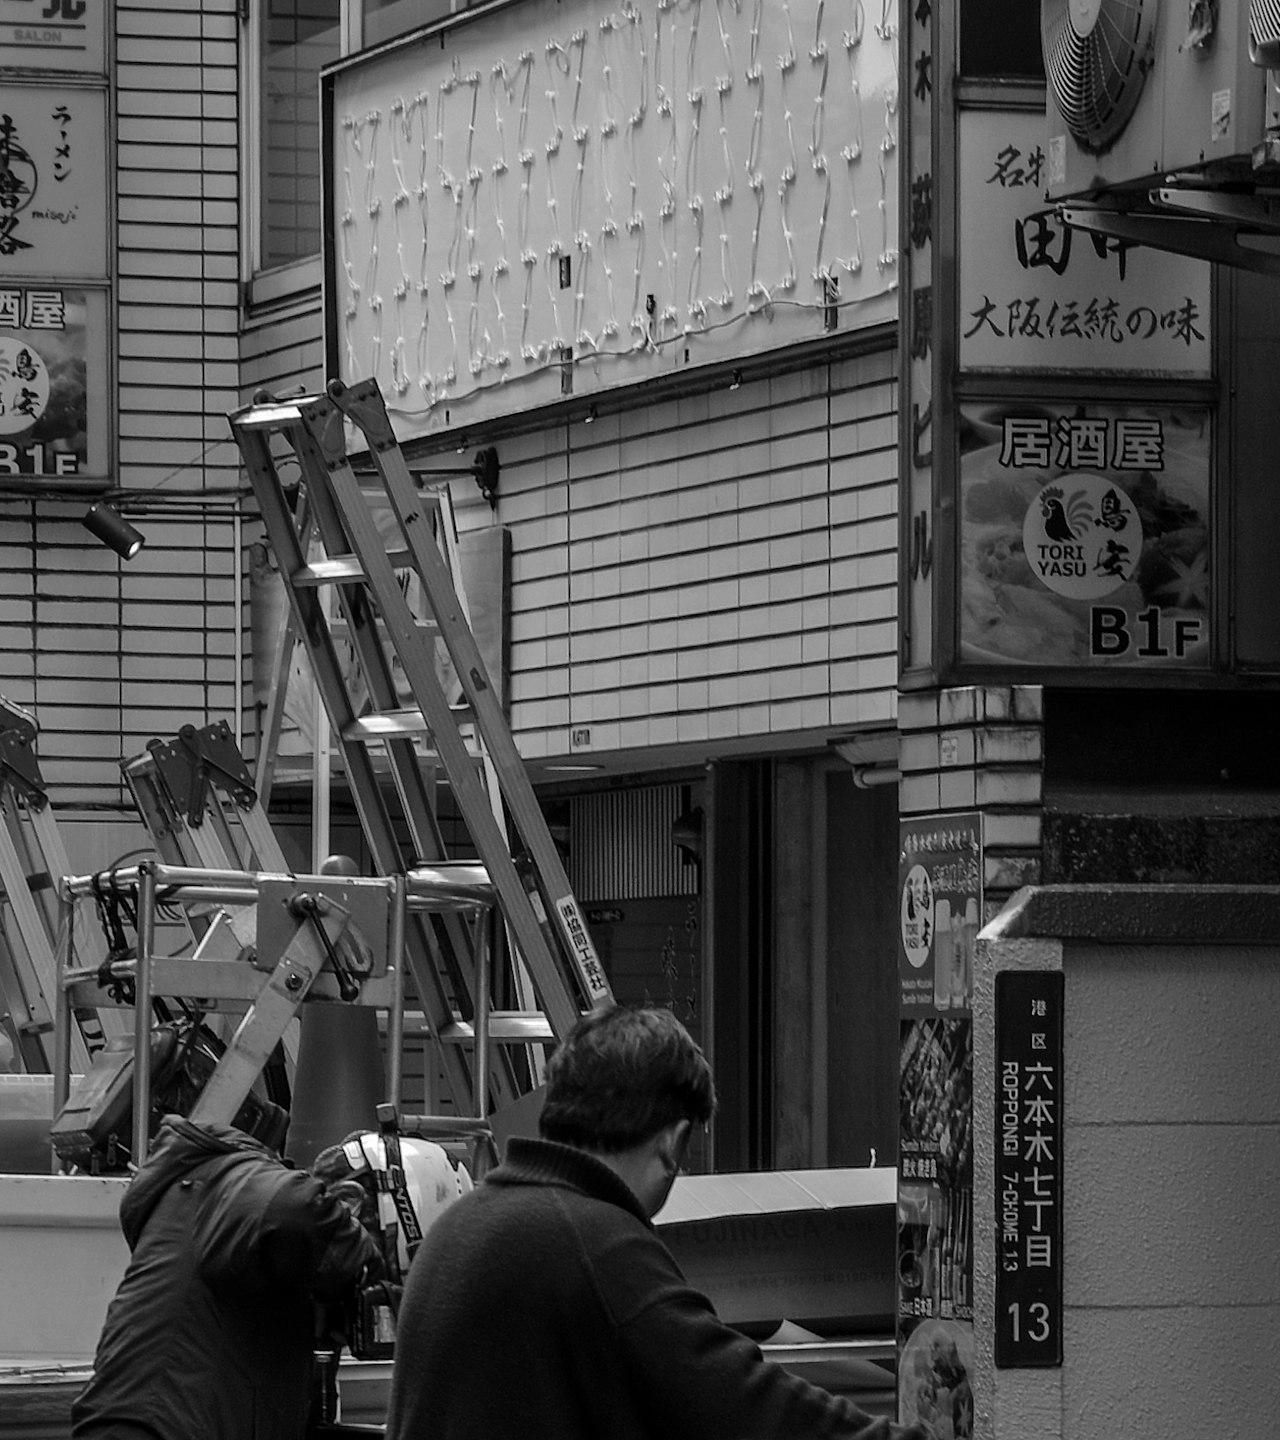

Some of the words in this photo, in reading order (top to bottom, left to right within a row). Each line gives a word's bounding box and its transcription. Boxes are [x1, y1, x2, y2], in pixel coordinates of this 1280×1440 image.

[14, 29, 62, 43] SALON
[52, 106, 71, 182] ラーメン
[964, 296, 1206, 346] 大阪伝統の味
[1000, 416, 1164, 470] 居酒屋
[1038, 545, 1083, 560] TORI
[1038, 561, 1086, 577] YASU
[1091, 606, 1200, 656] B1F
[1031, 999, 1048, 1050] 港区
[1001, 1061, 1019, 1157] ROPPONGI
[1023, 1061, 1055, 1268] 六本木七丁目
[1001, 1172, 1019, 1243] 7-CHOME
[1001, 1250, 1019, 1272] 13
[1007, 1302, 1052, 1343] 13
